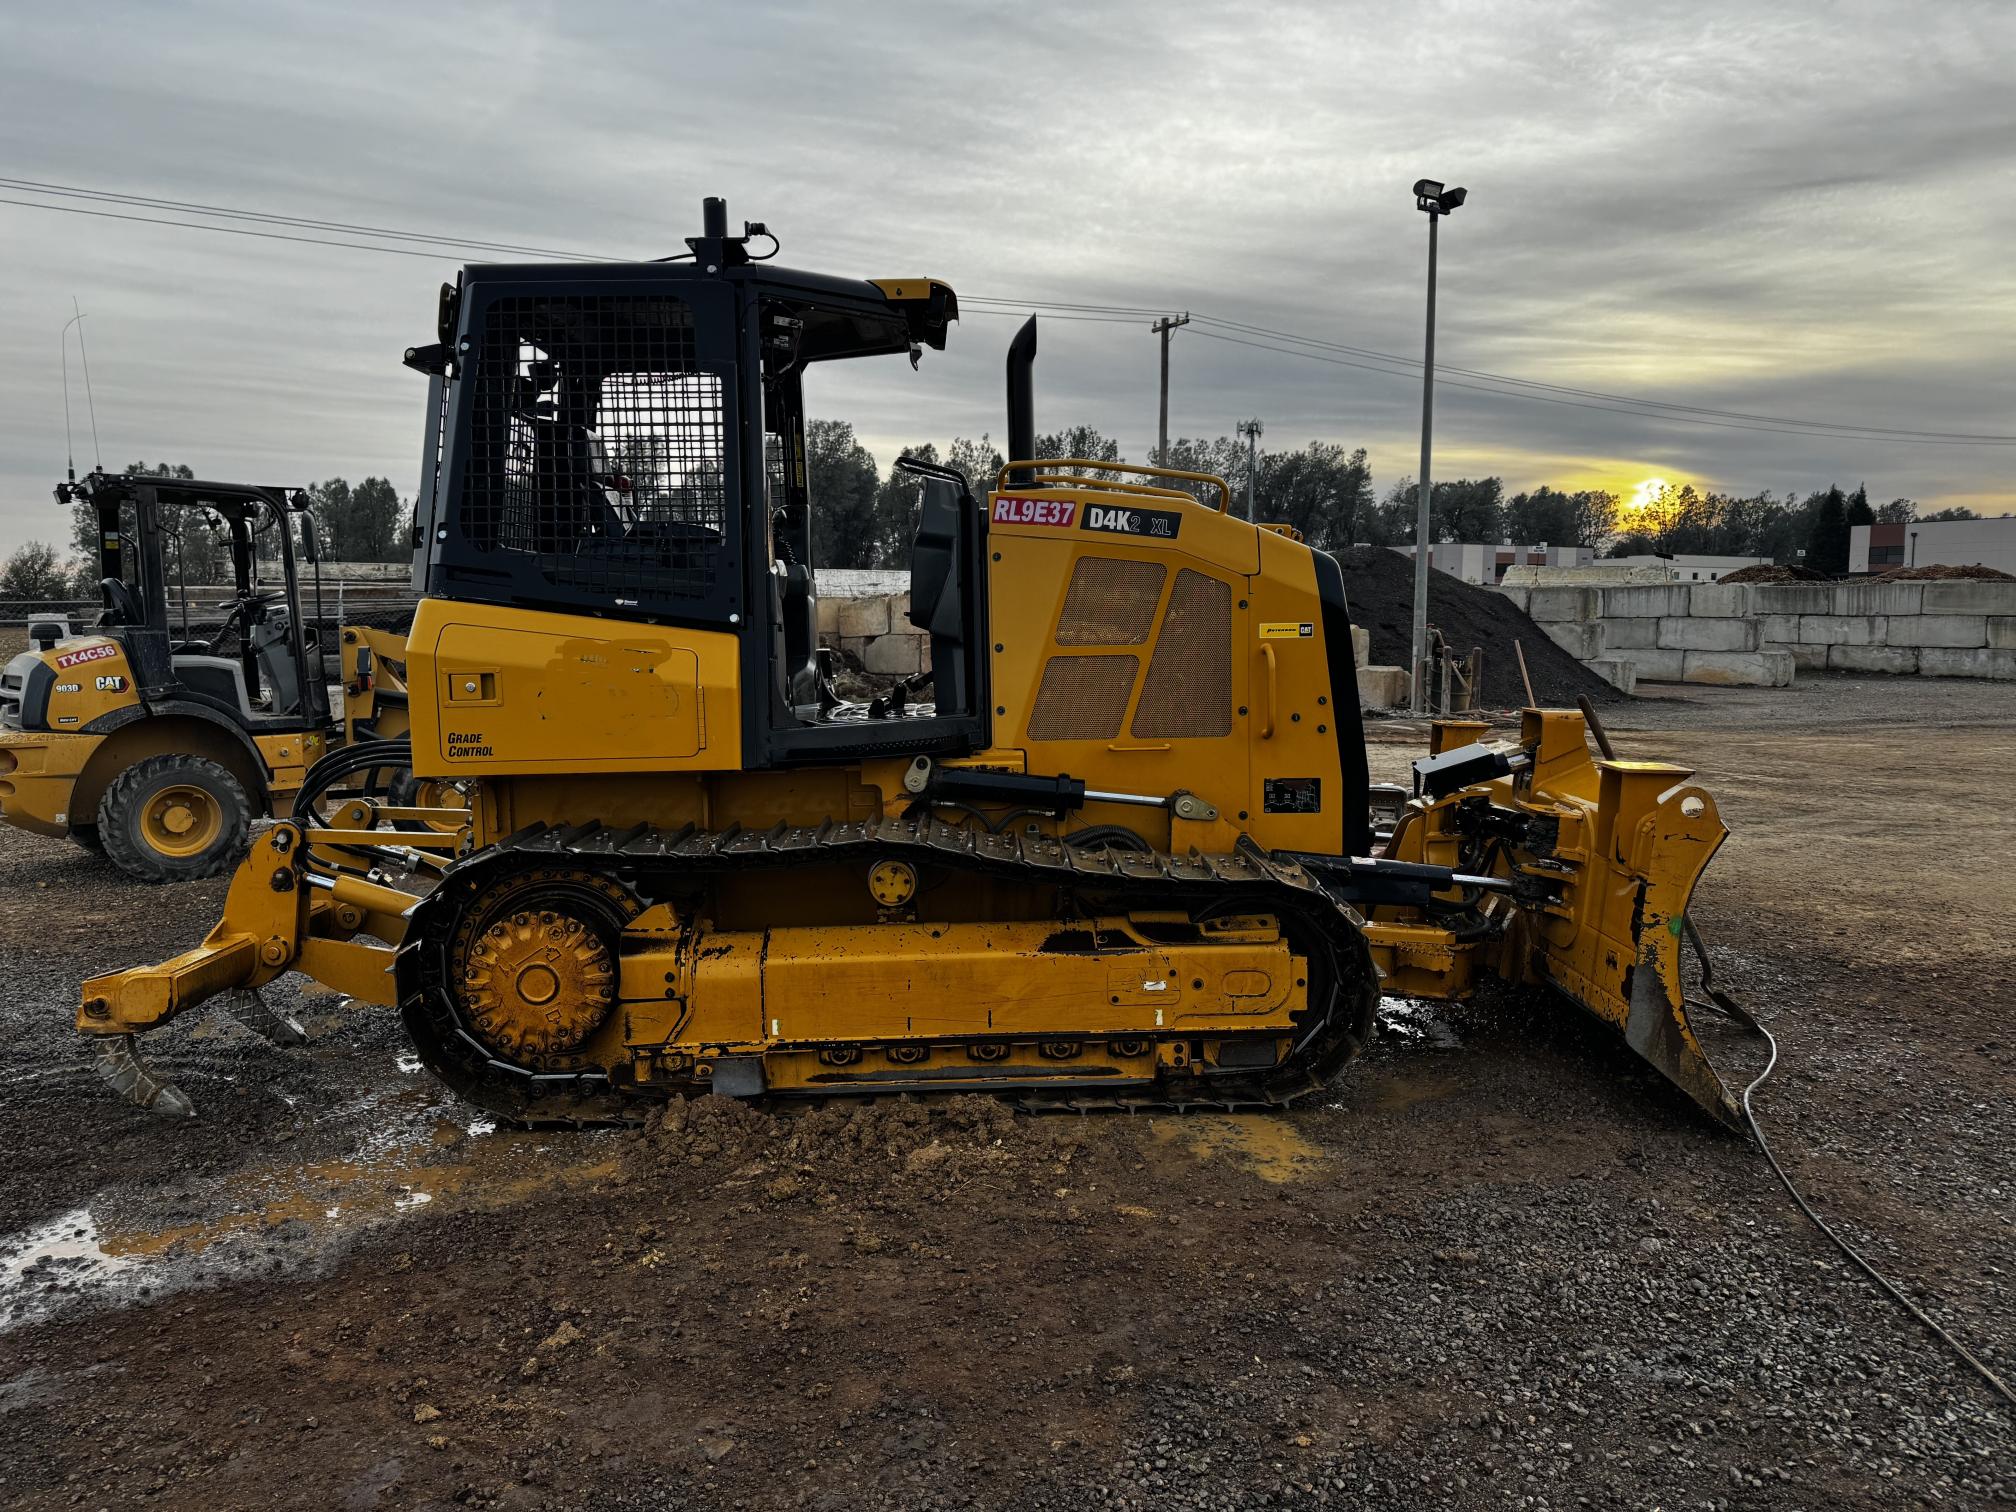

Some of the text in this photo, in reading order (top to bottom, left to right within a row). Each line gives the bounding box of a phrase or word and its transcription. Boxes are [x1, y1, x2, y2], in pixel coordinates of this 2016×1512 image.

[994, 499, 1075, 524] RL9E37
[1089, 507, 1172, 536] D4K2 XL
[1300, 626, 1312, 634] CAT
[57, 645, 116, 667] TX4C56
[95, 676, 121, 691] CAT
[447, 732, 483, 744] GRADE
[448, 745, 494, 757] CONTROL
